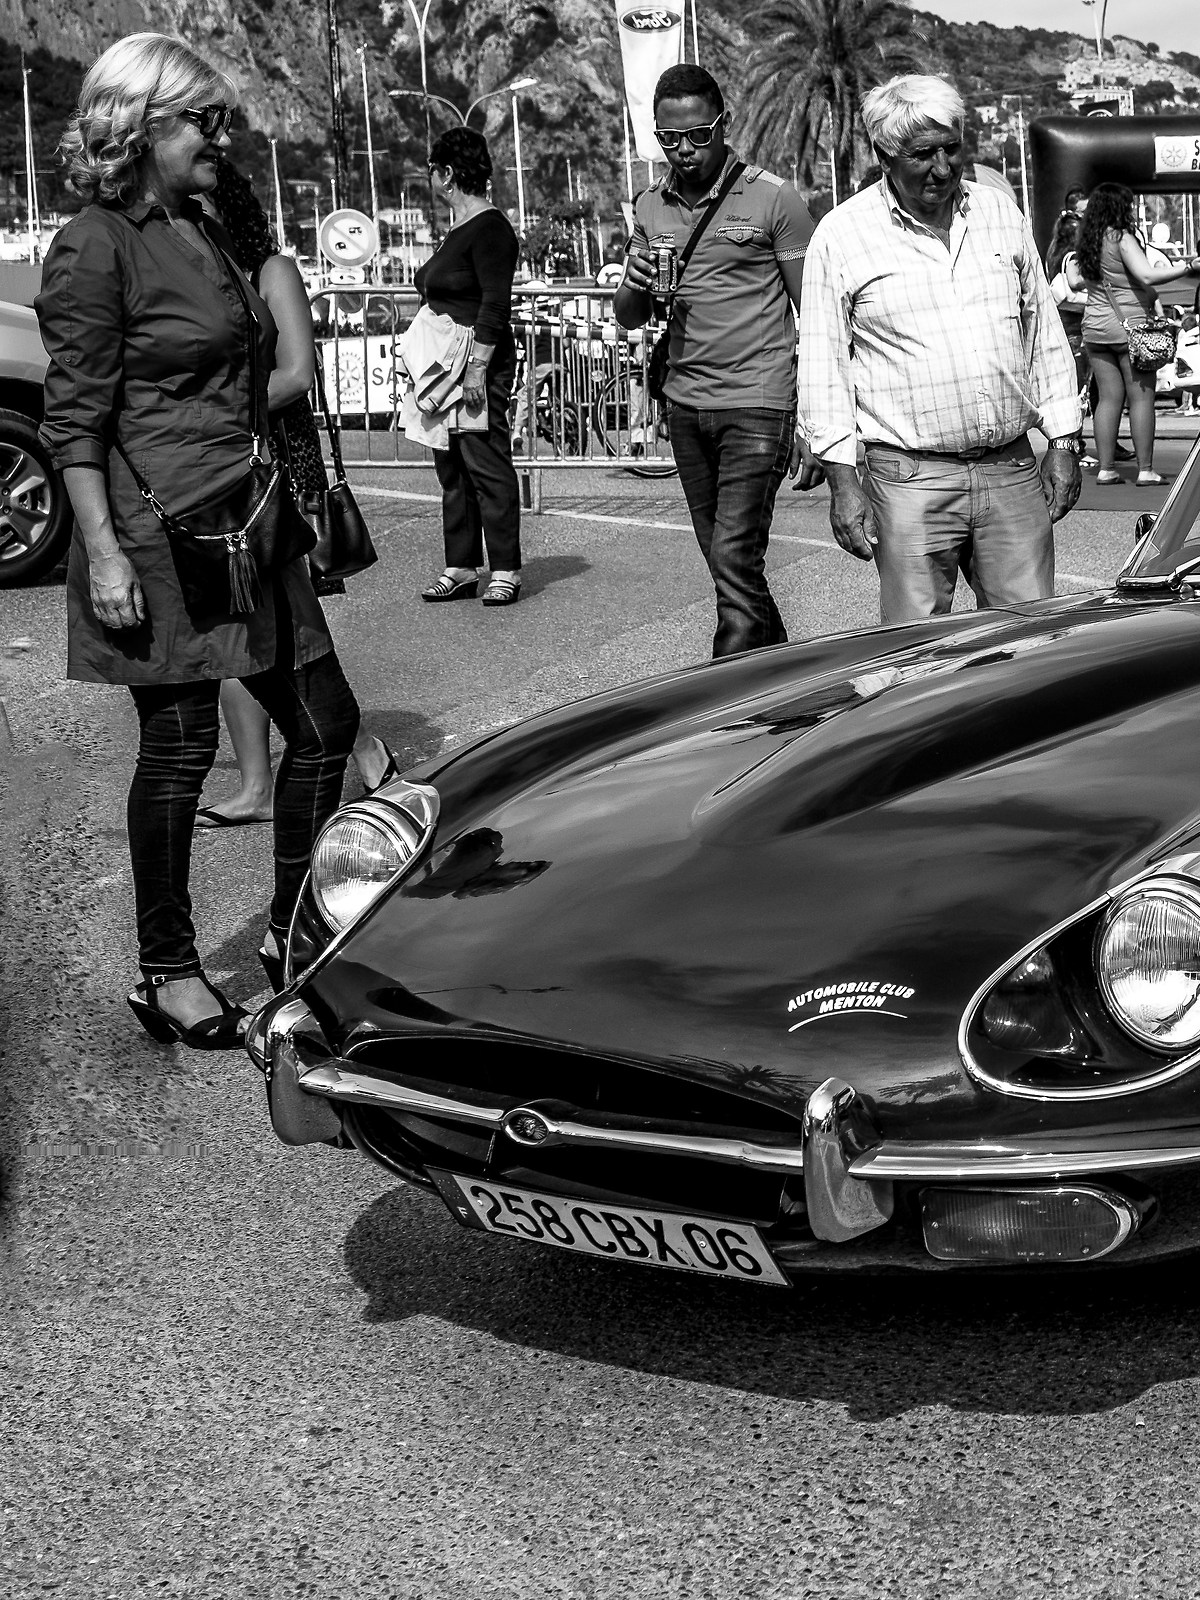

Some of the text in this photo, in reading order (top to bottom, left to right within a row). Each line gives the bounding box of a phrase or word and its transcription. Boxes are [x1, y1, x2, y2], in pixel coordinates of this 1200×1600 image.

[787, 982, 915, 1012] AUTOMOBILE CLUB
[819, 995, 887, 1014] MENTON
[469, 1185, 763, 1277] 258 CBX 06
